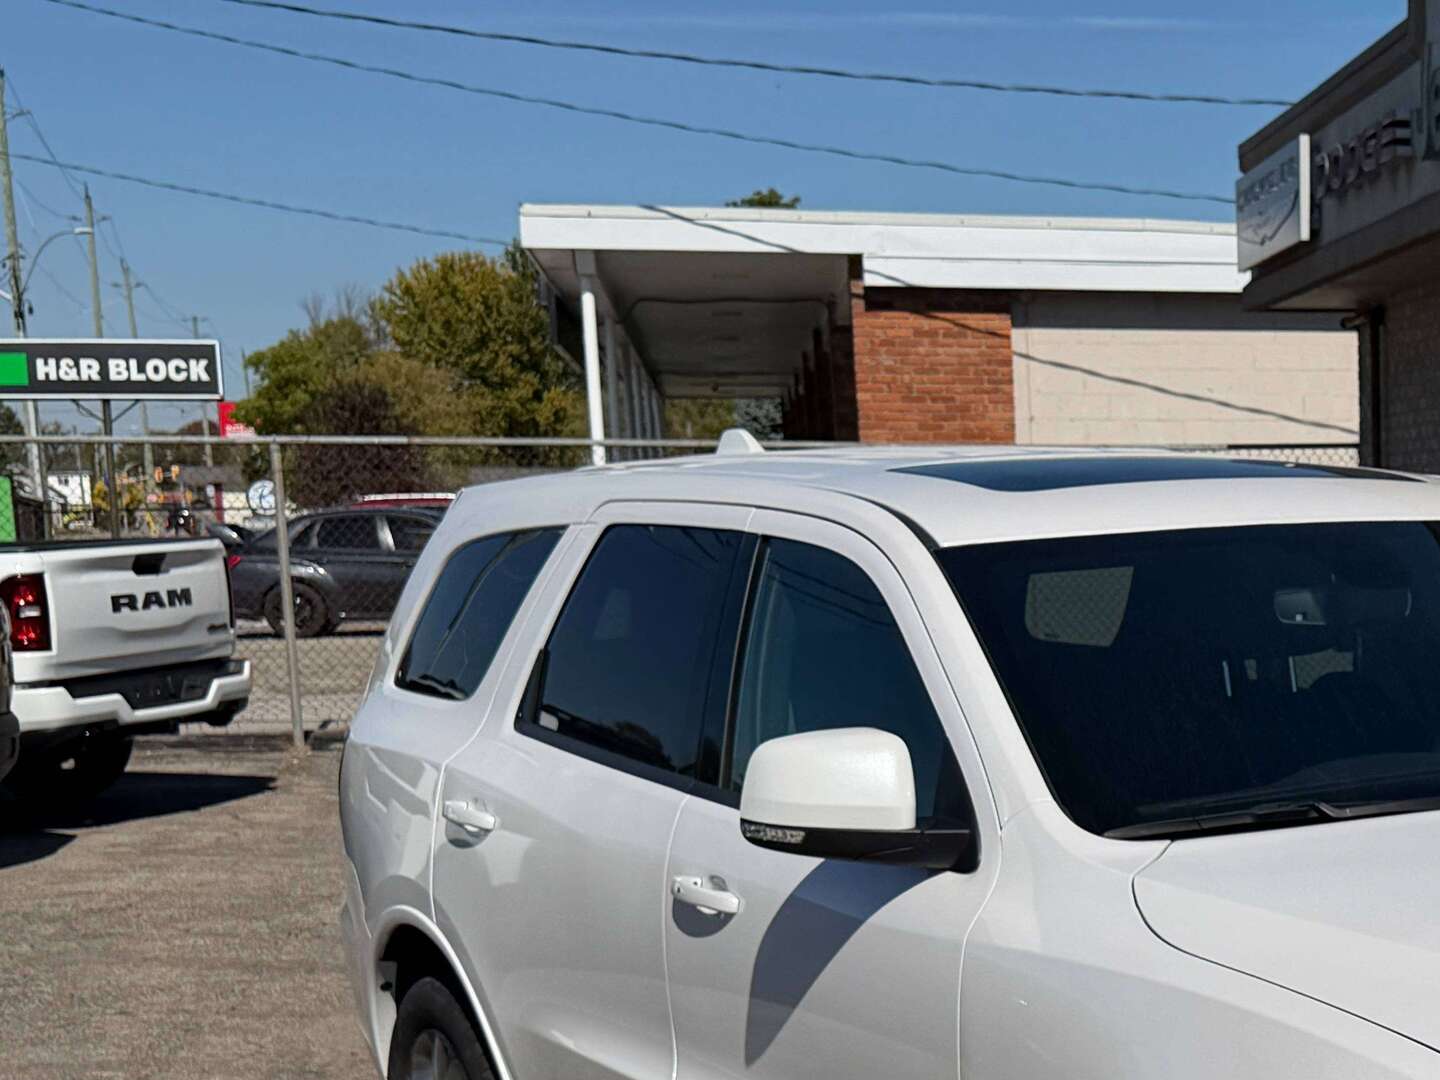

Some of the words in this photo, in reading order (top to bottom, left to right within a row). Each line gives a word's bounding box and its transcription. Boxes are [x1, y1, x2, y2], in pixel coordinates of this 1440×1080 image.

[35, 357, 101, 382] H&R
[107, 357, 210, 383] BLOCK
[110, 587, 193, 614] RAM
